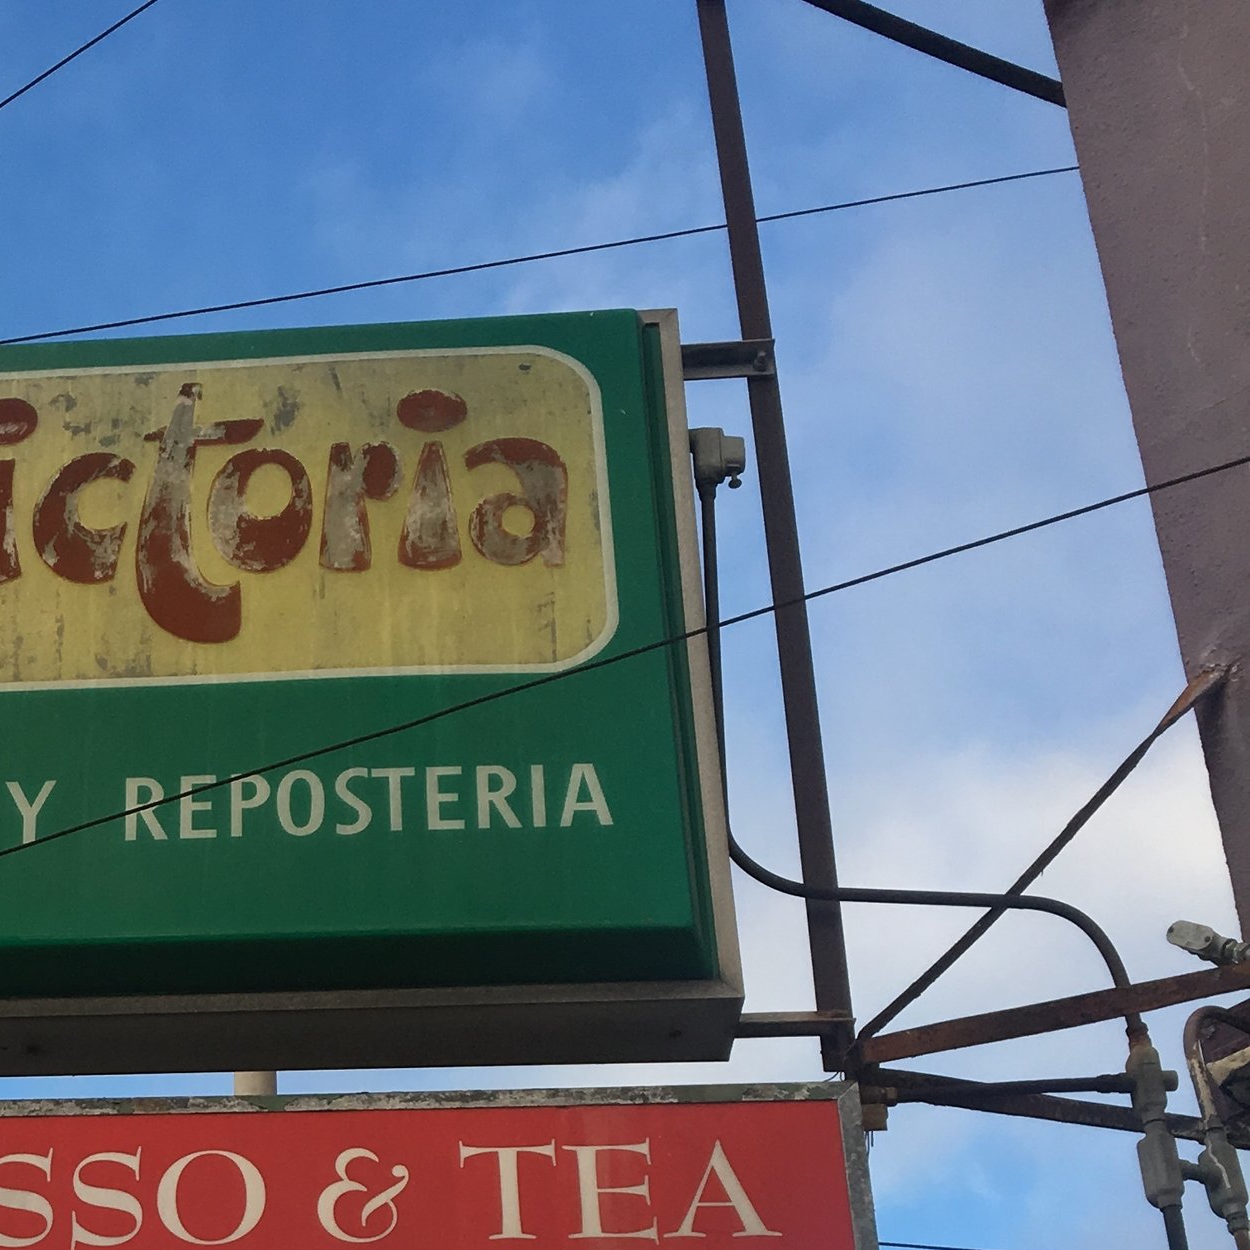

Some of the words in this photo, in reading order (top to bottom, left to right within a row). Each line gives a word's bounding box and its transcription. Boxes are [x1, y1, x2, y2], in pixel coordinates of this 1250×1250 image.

[6, 779, 57, 845] Y
[124, 763, 614, 841] REPOSTERIA
[317, 1147, 409, 1243] &
[459, 1137, 783, 1245] TEA
